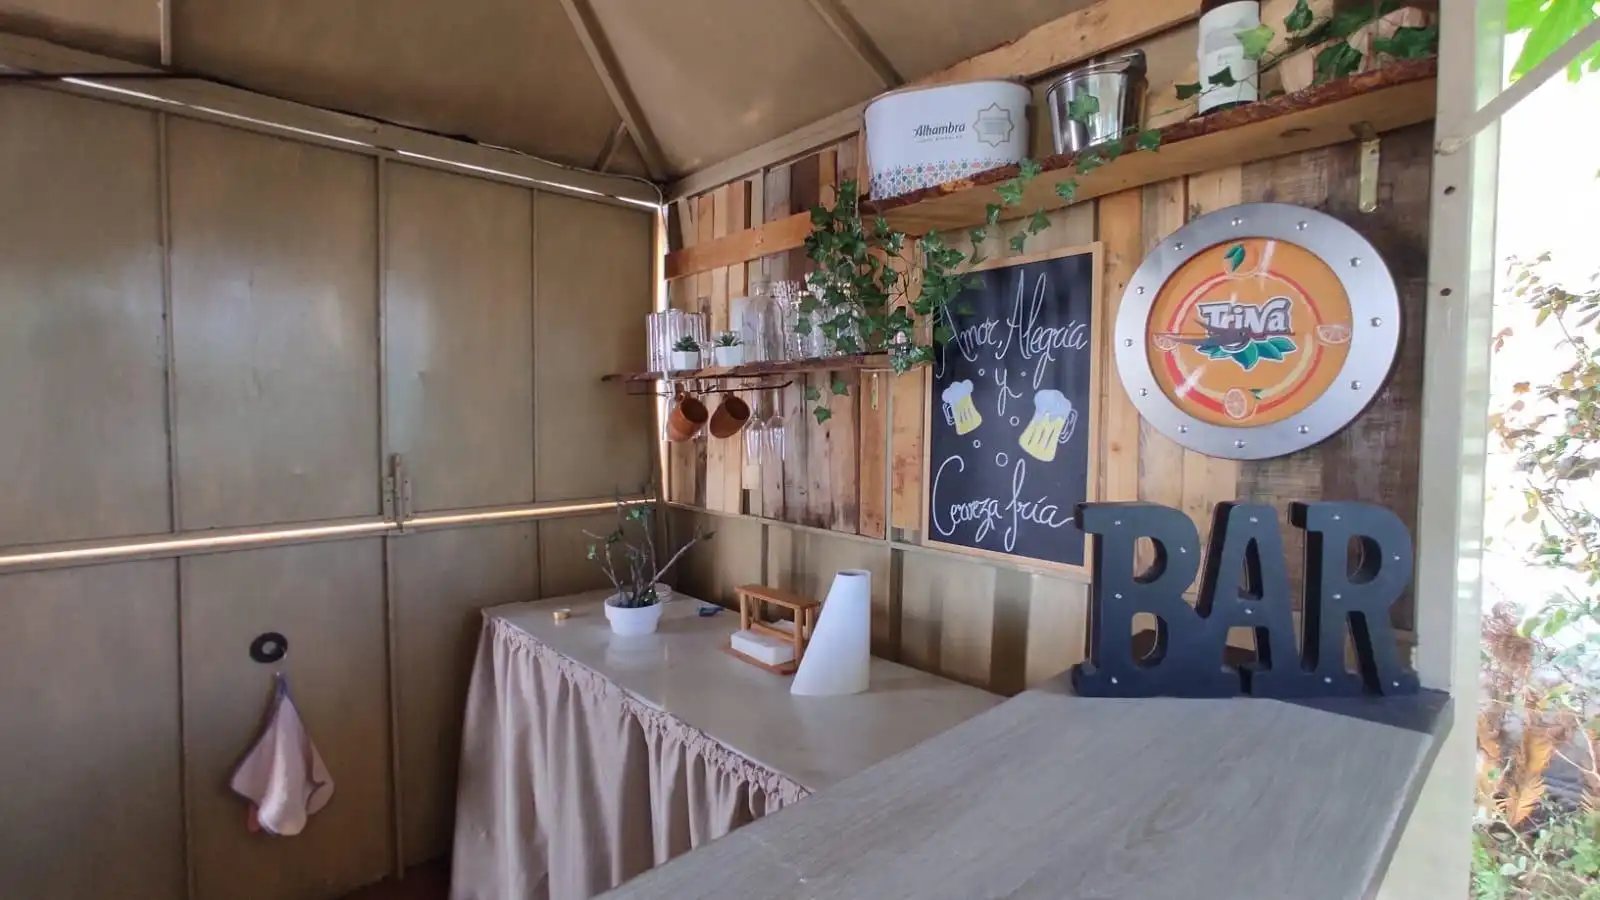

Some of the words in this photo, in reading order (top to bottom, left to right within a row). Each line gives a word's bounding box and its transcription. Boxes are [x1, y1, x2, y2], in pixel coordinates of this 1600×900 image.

[913, 122, 965, 136] Alhambra
[995, 269, 1088, 389] Alegría
[995, 367, 1023, 416] y
[932, 455, 1002, 542] Cerveza
[1004, 458, 1075, 552] fría
[1072, 501, 1419, 697] BAR
